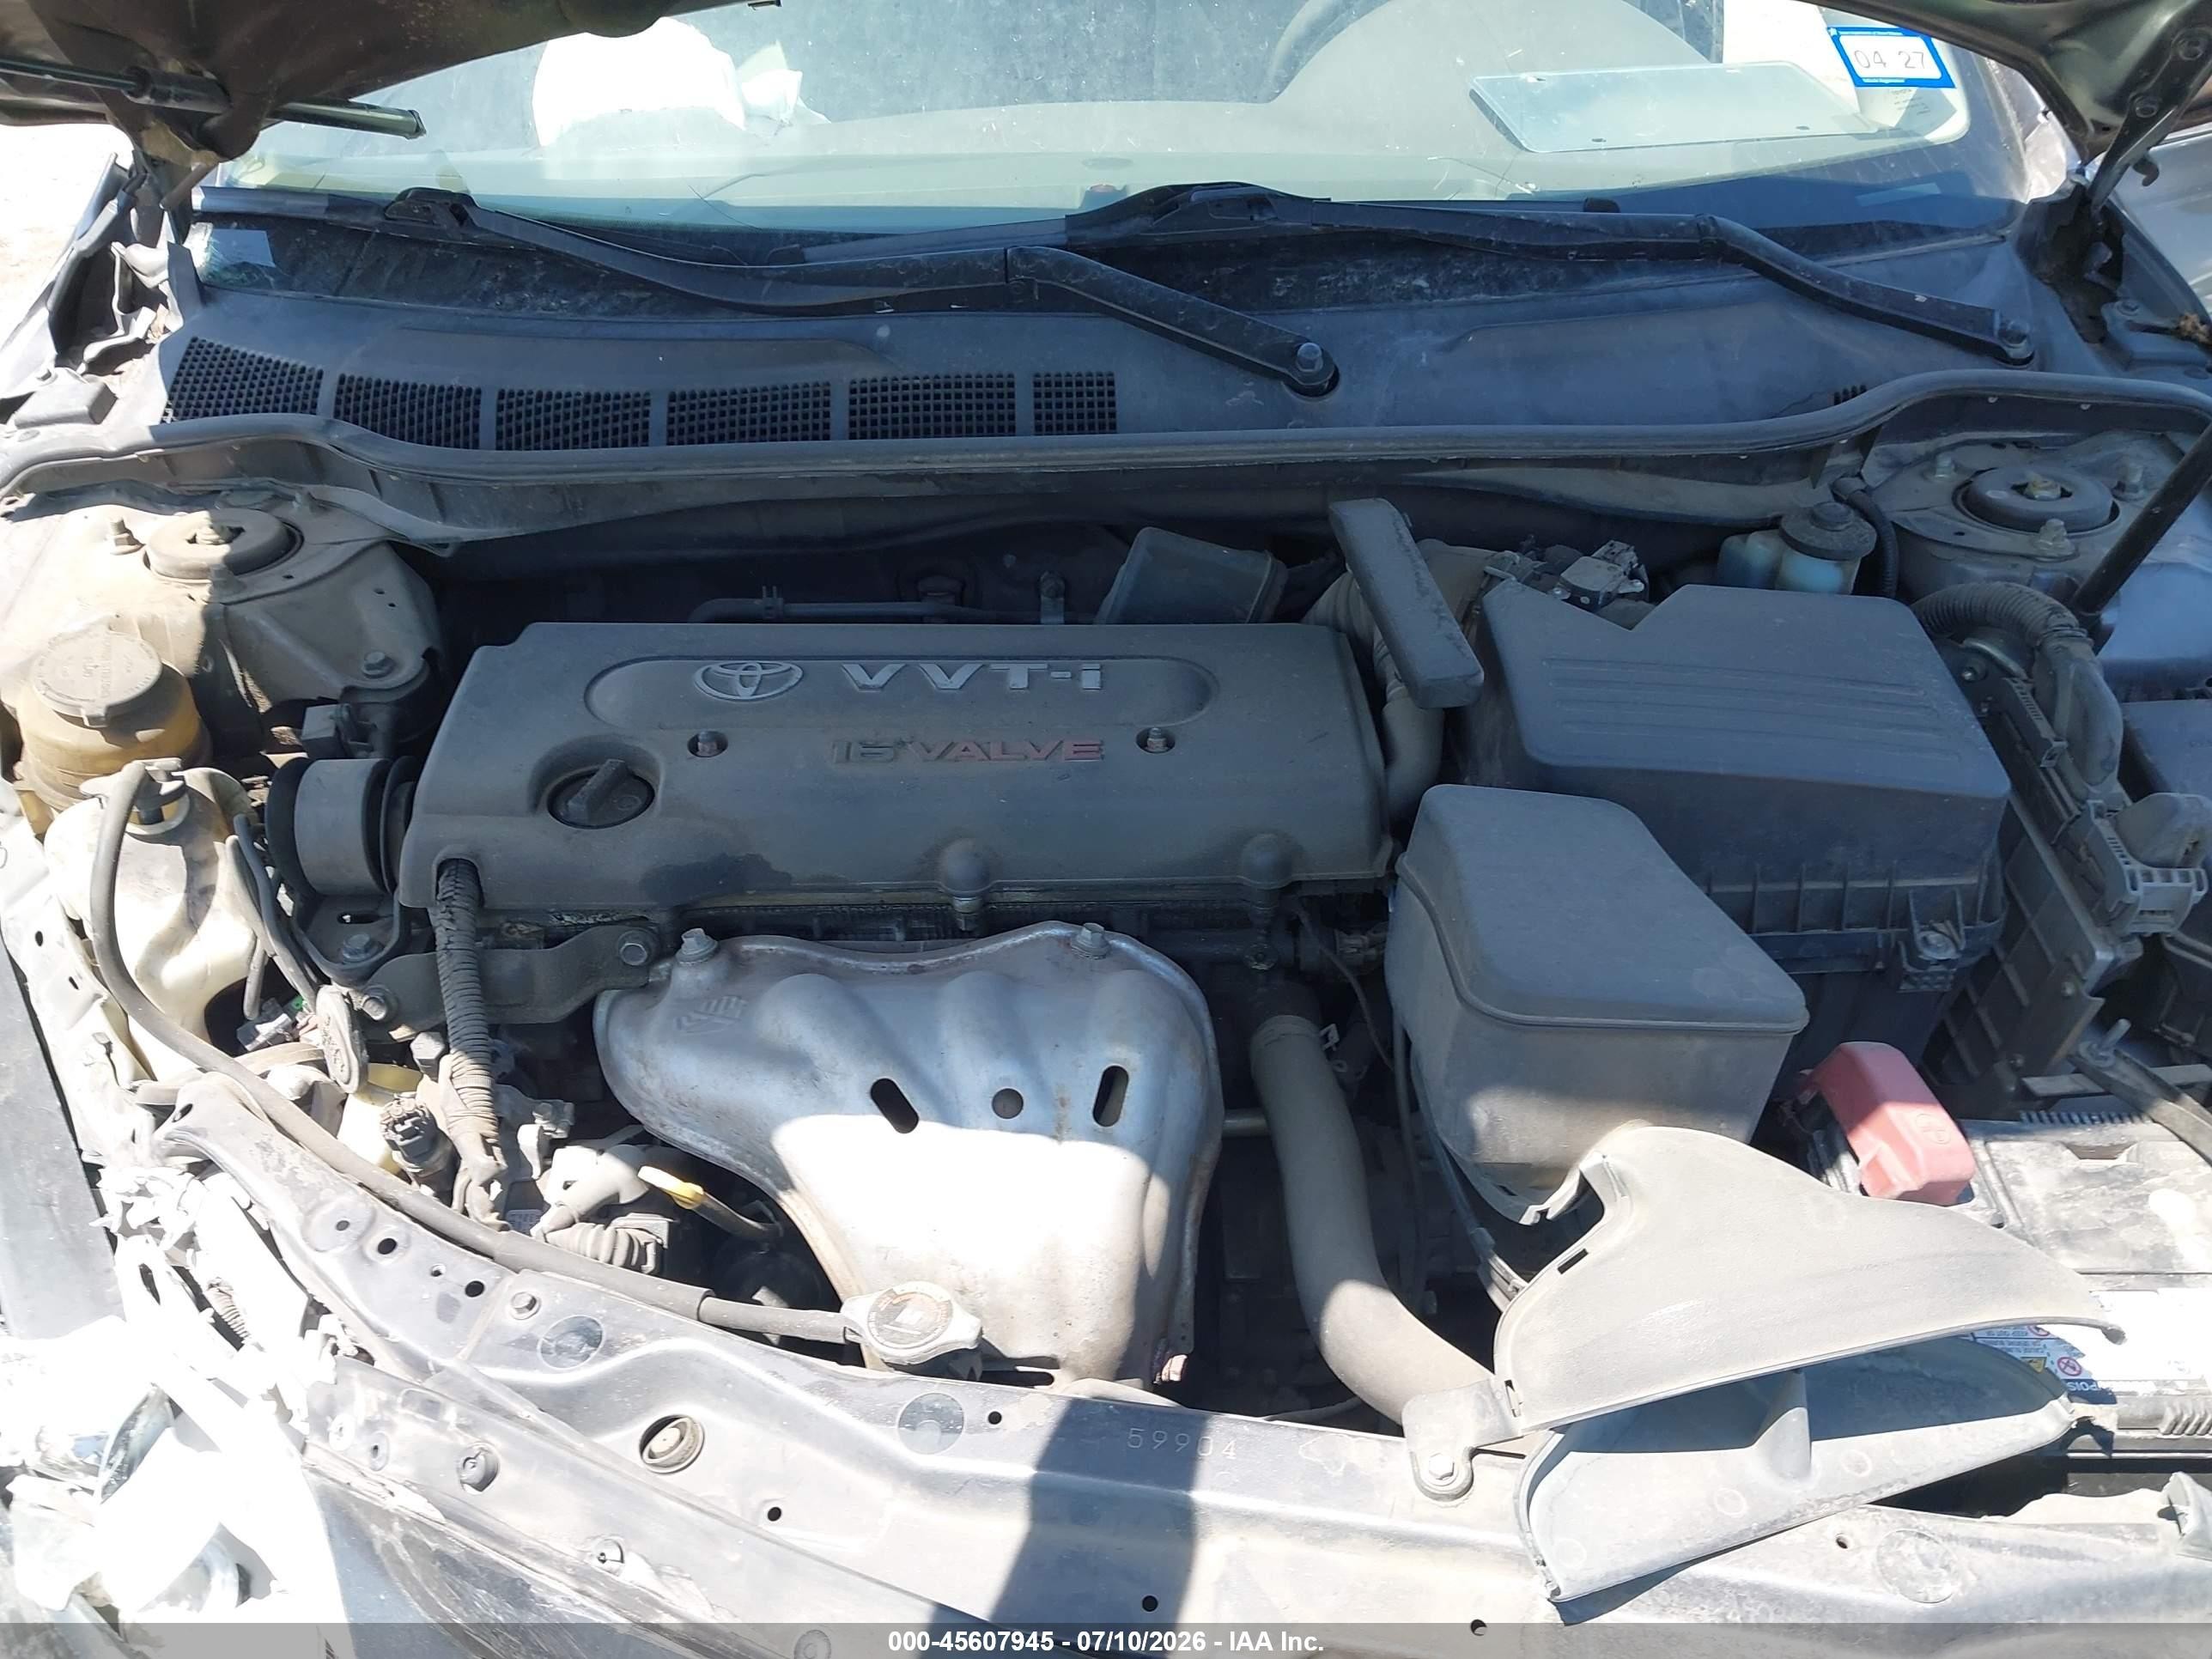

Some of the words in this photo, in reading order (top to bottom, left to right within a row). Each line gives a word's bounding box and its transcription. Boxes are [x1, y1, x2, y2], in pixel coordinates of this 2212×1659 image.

[1854, 50, 1887, 69] 04
[1898, 51, 1926, 69] 27
[907, 739, 1104, 762] VALVE
